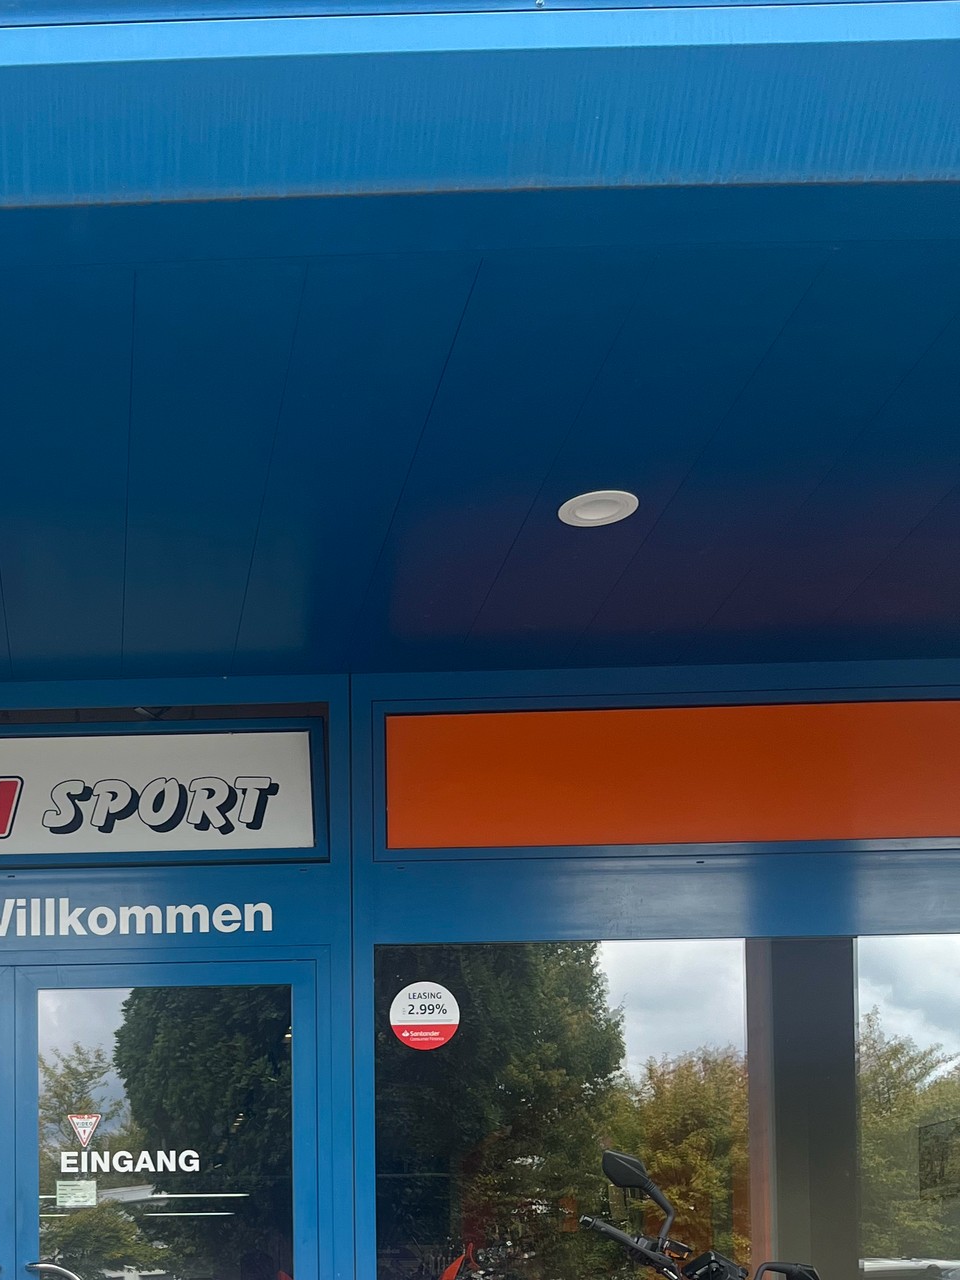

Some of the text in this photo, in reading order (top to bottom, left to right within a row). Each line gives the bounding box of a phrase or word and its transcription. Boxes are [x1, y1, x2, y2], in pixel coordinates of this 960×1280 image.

[42, 775, 279, 835] SPORT
[408, 992, 442, 1000] LEASING
[408, 1003, 447, 1015] 2.99%
[60, 1150, 200, 1173] EINGANG
